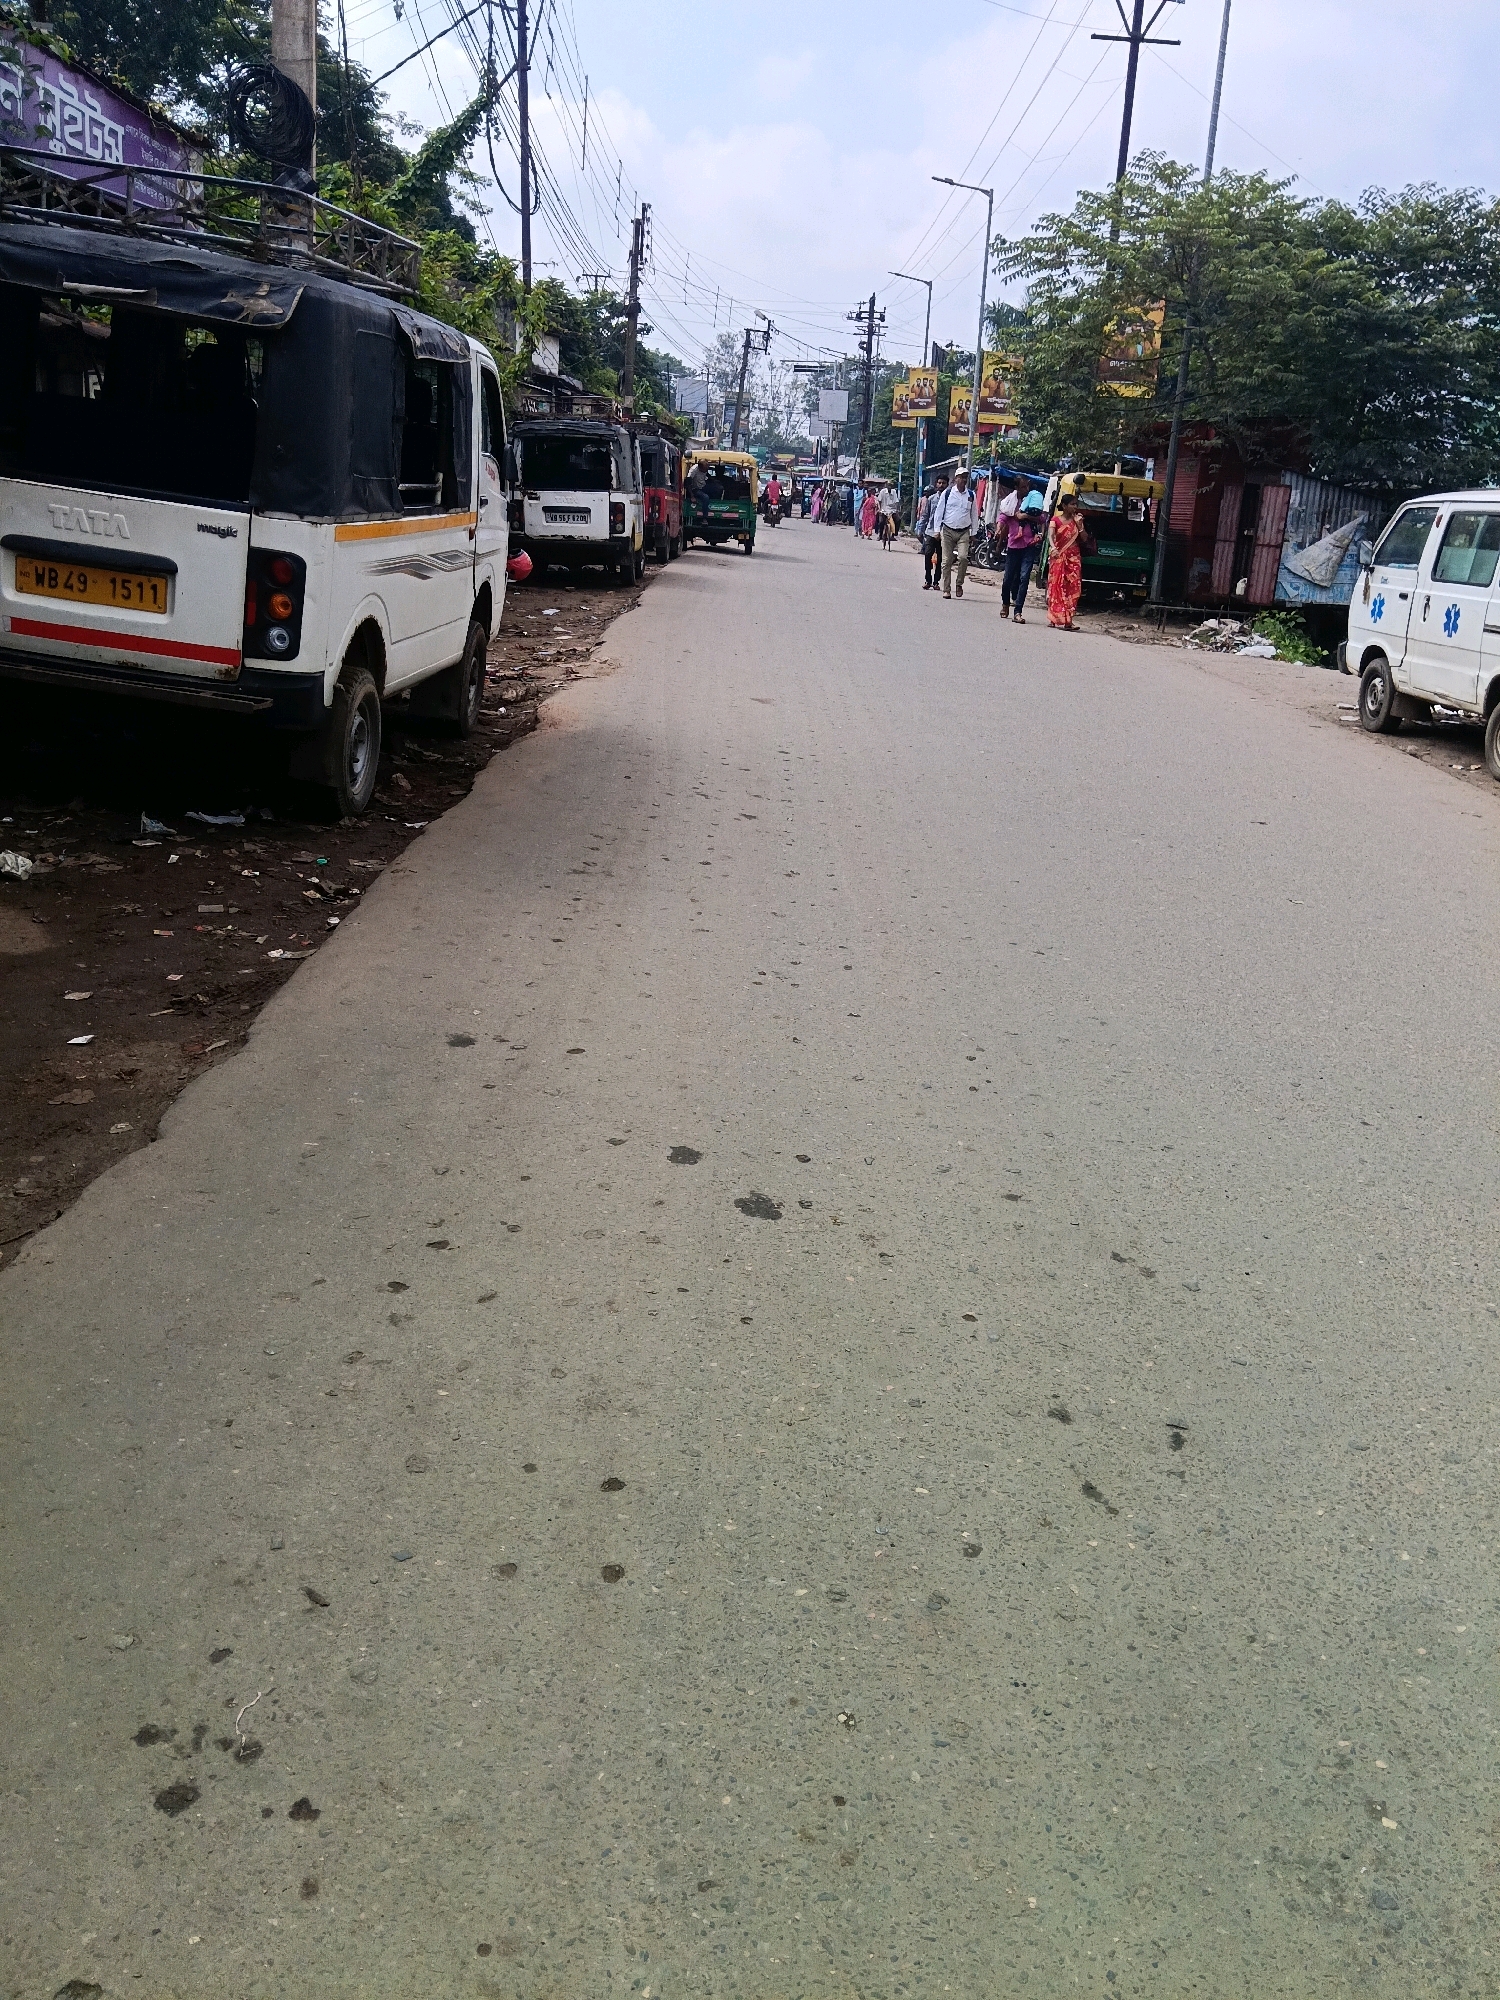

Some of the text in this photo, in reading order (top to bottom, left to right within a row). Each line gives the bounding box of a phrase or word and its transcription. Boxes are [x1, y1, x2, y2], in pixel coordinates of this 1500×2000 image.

[48, 503, 131, 540] TATA
[197, 522, 238, 539] magic
[109, 577, 158, 605] 1511
